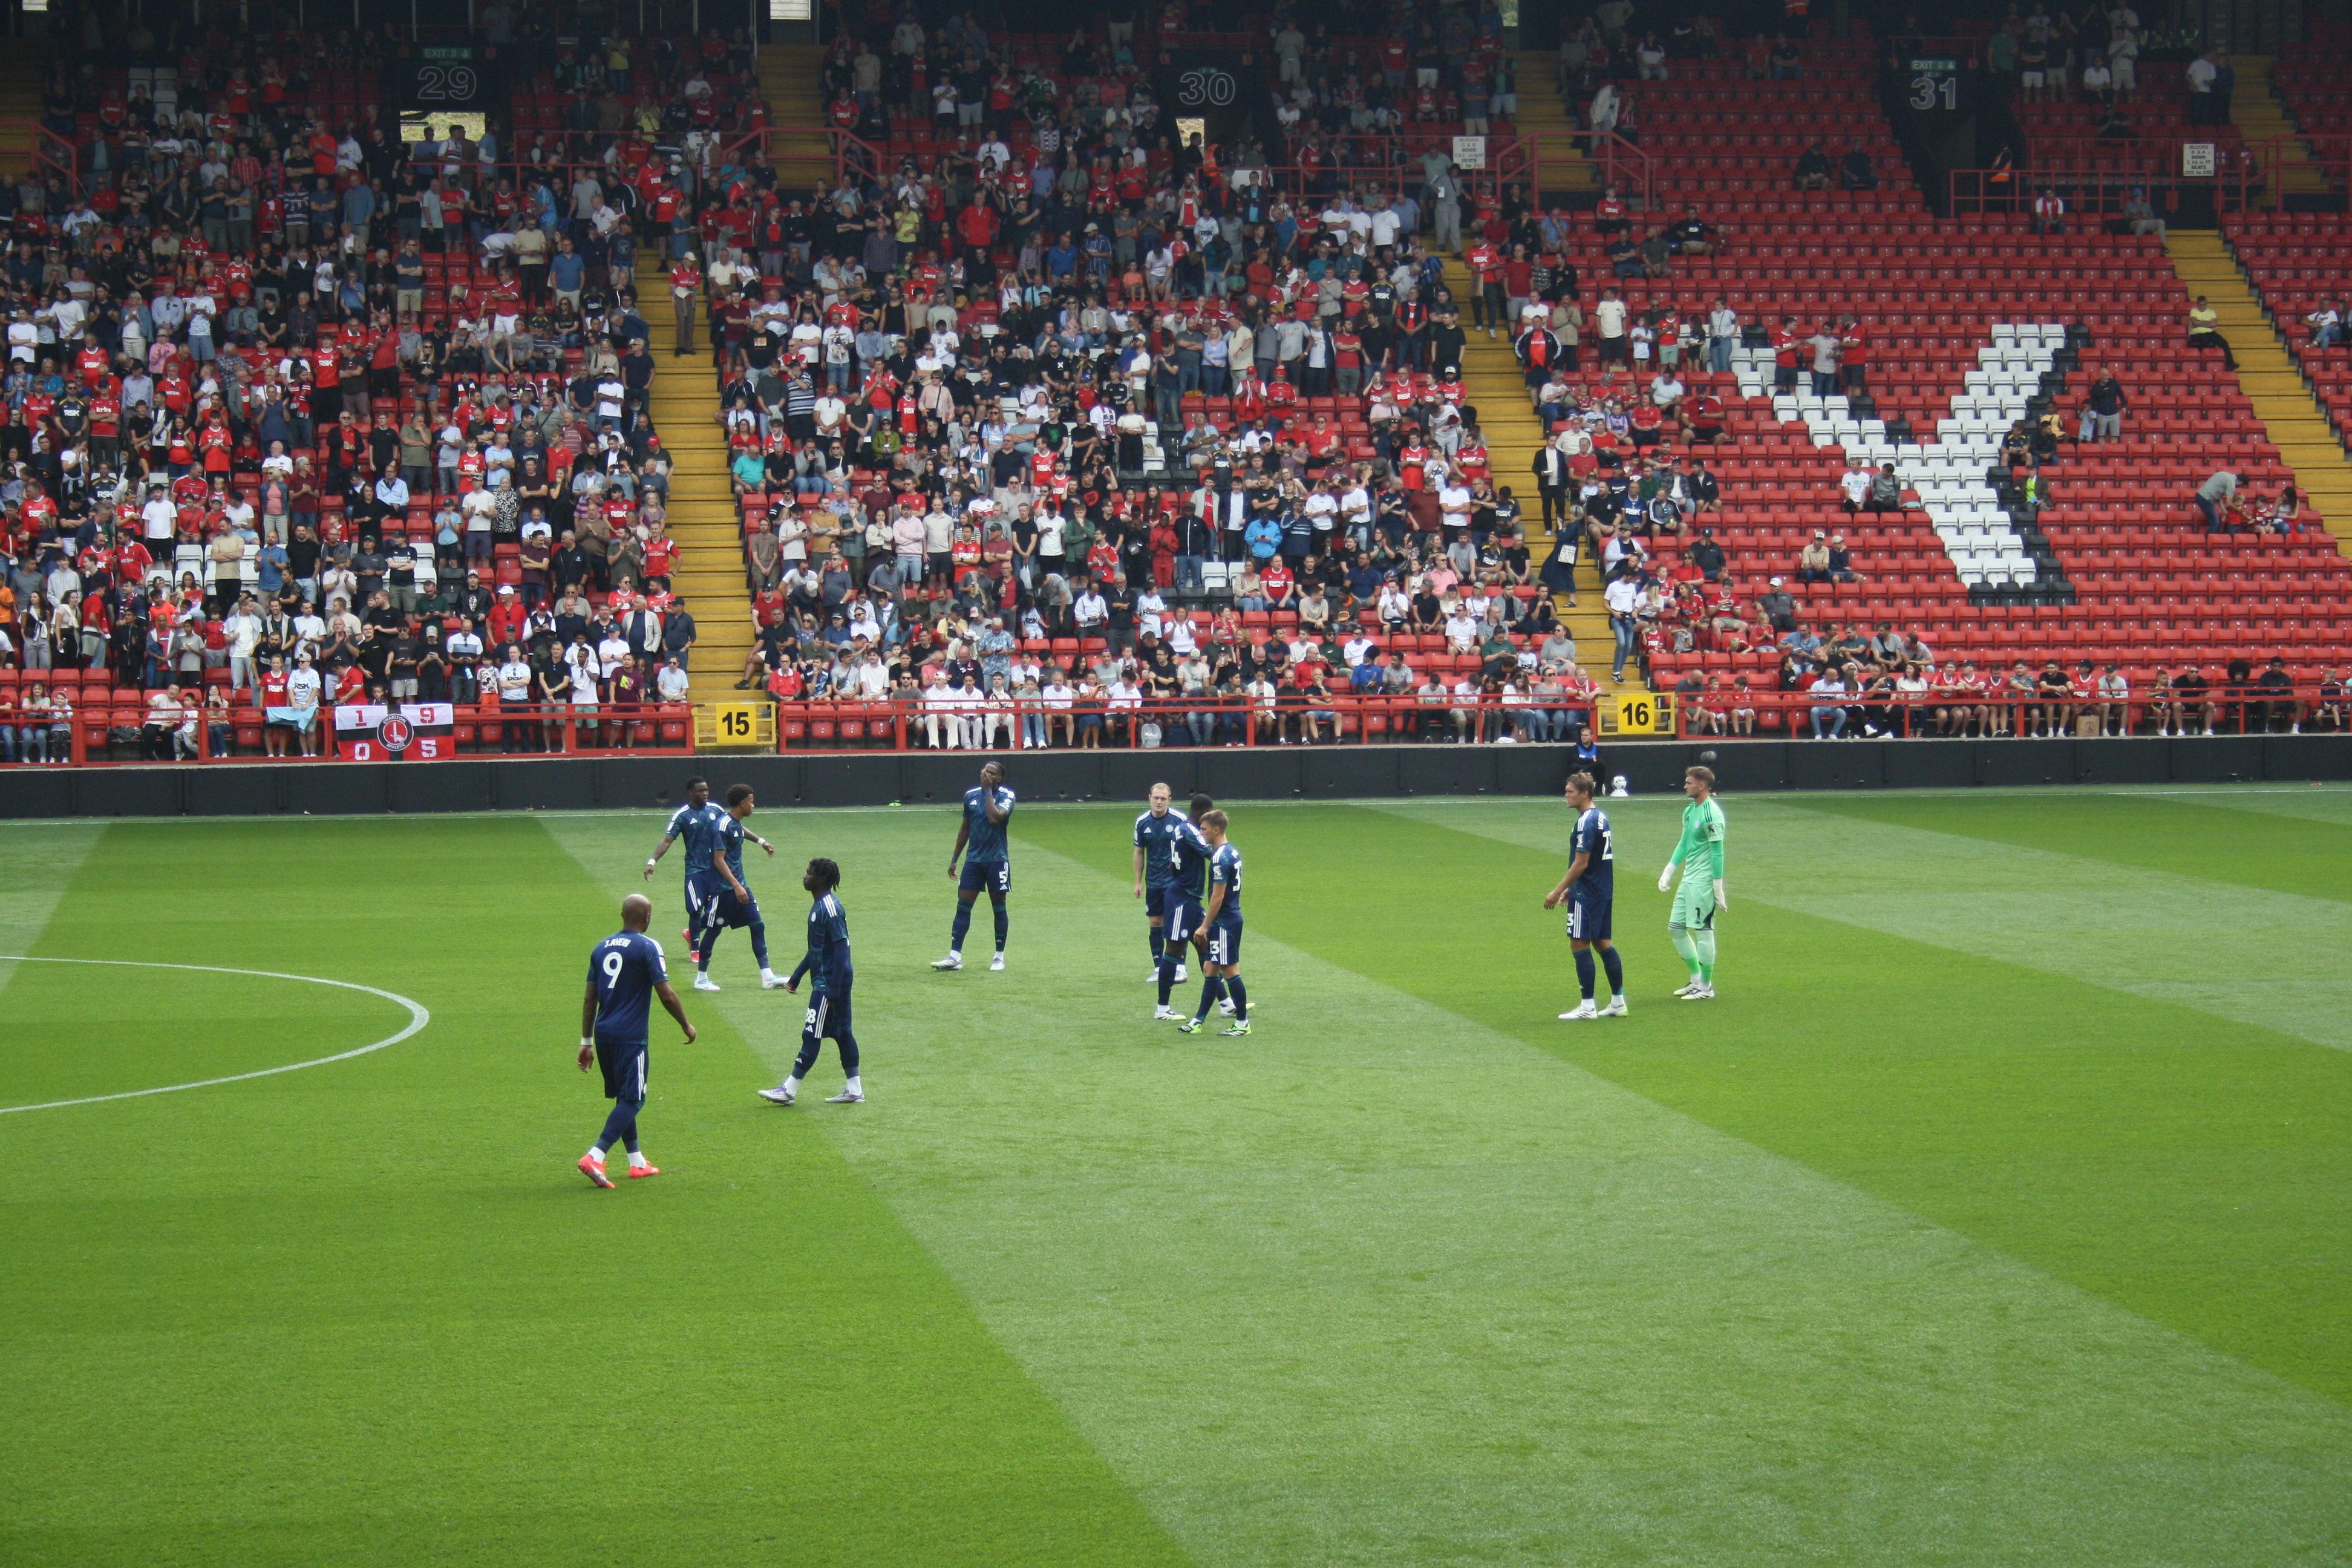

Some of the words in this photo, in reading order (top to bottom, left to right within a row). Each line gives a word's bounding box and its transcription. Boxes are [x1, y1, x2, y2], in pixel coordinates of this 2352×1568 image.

[425, 49, 446, 57] EXIT
[1912, 60, 1935, 69] EXIT
[418, 67, 476, 100] 29
[1179, 72, 1235, 105] 30
[1910, 77, 1955, 109] 31
[1483, 557, 1497, 566] RSK
[356, 710, 367, 727] 1
[420, 707, 434, 723] 9
[383, 715, 407, 724] CHARLTON
[722, 712, 750, 736] 15
[1622, 702, 1649, 726] 16
[354, 742, 370, 760] 0
[421, 740, 437, 757] 5
[999, 871, 1008, 884] 5
[1695, 907, 1700, 919] 1
[604, 938, 631, 948] J.AYEW
[603, 952, 622, 988] 9
